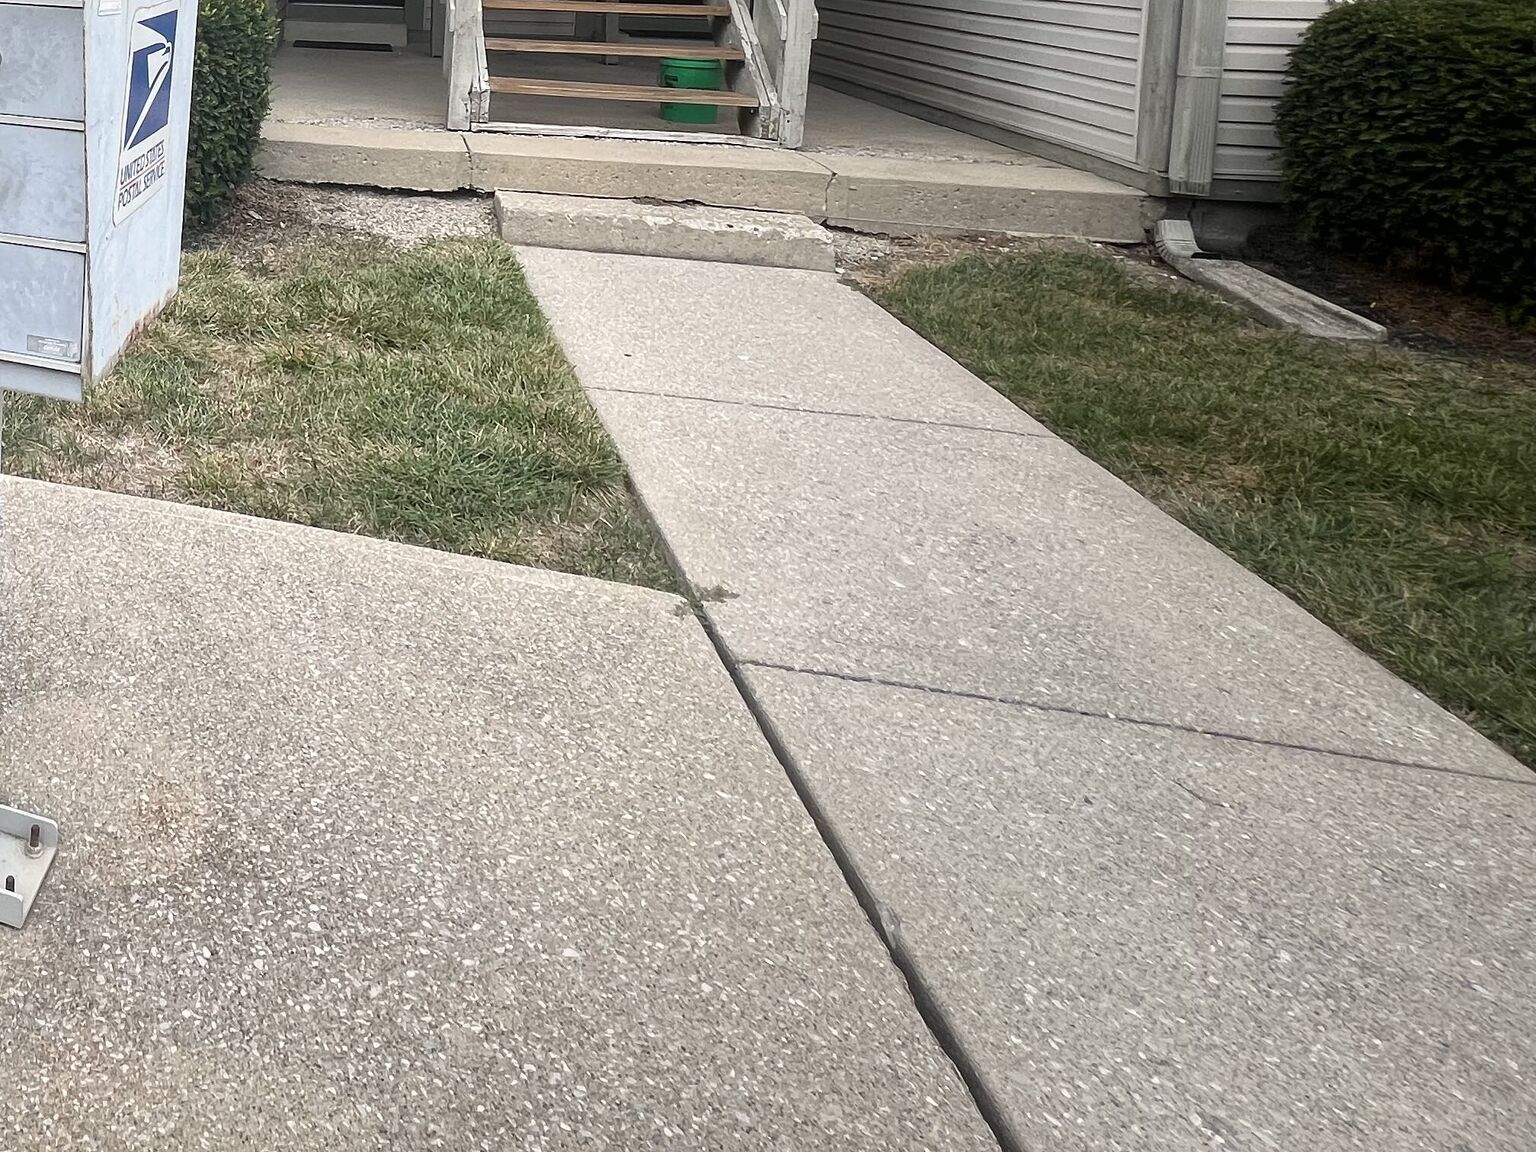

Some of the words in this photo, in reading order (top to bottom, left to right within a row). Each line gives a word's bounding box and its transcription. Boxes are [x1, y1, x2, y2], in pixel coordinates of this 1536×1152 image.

[118, 178, 142, 211] POSTAL
[143, 159, 165, 192] SERVICE
[120, 154, 145, 185] UNITED
[145, 139, 165, 168] STATES
